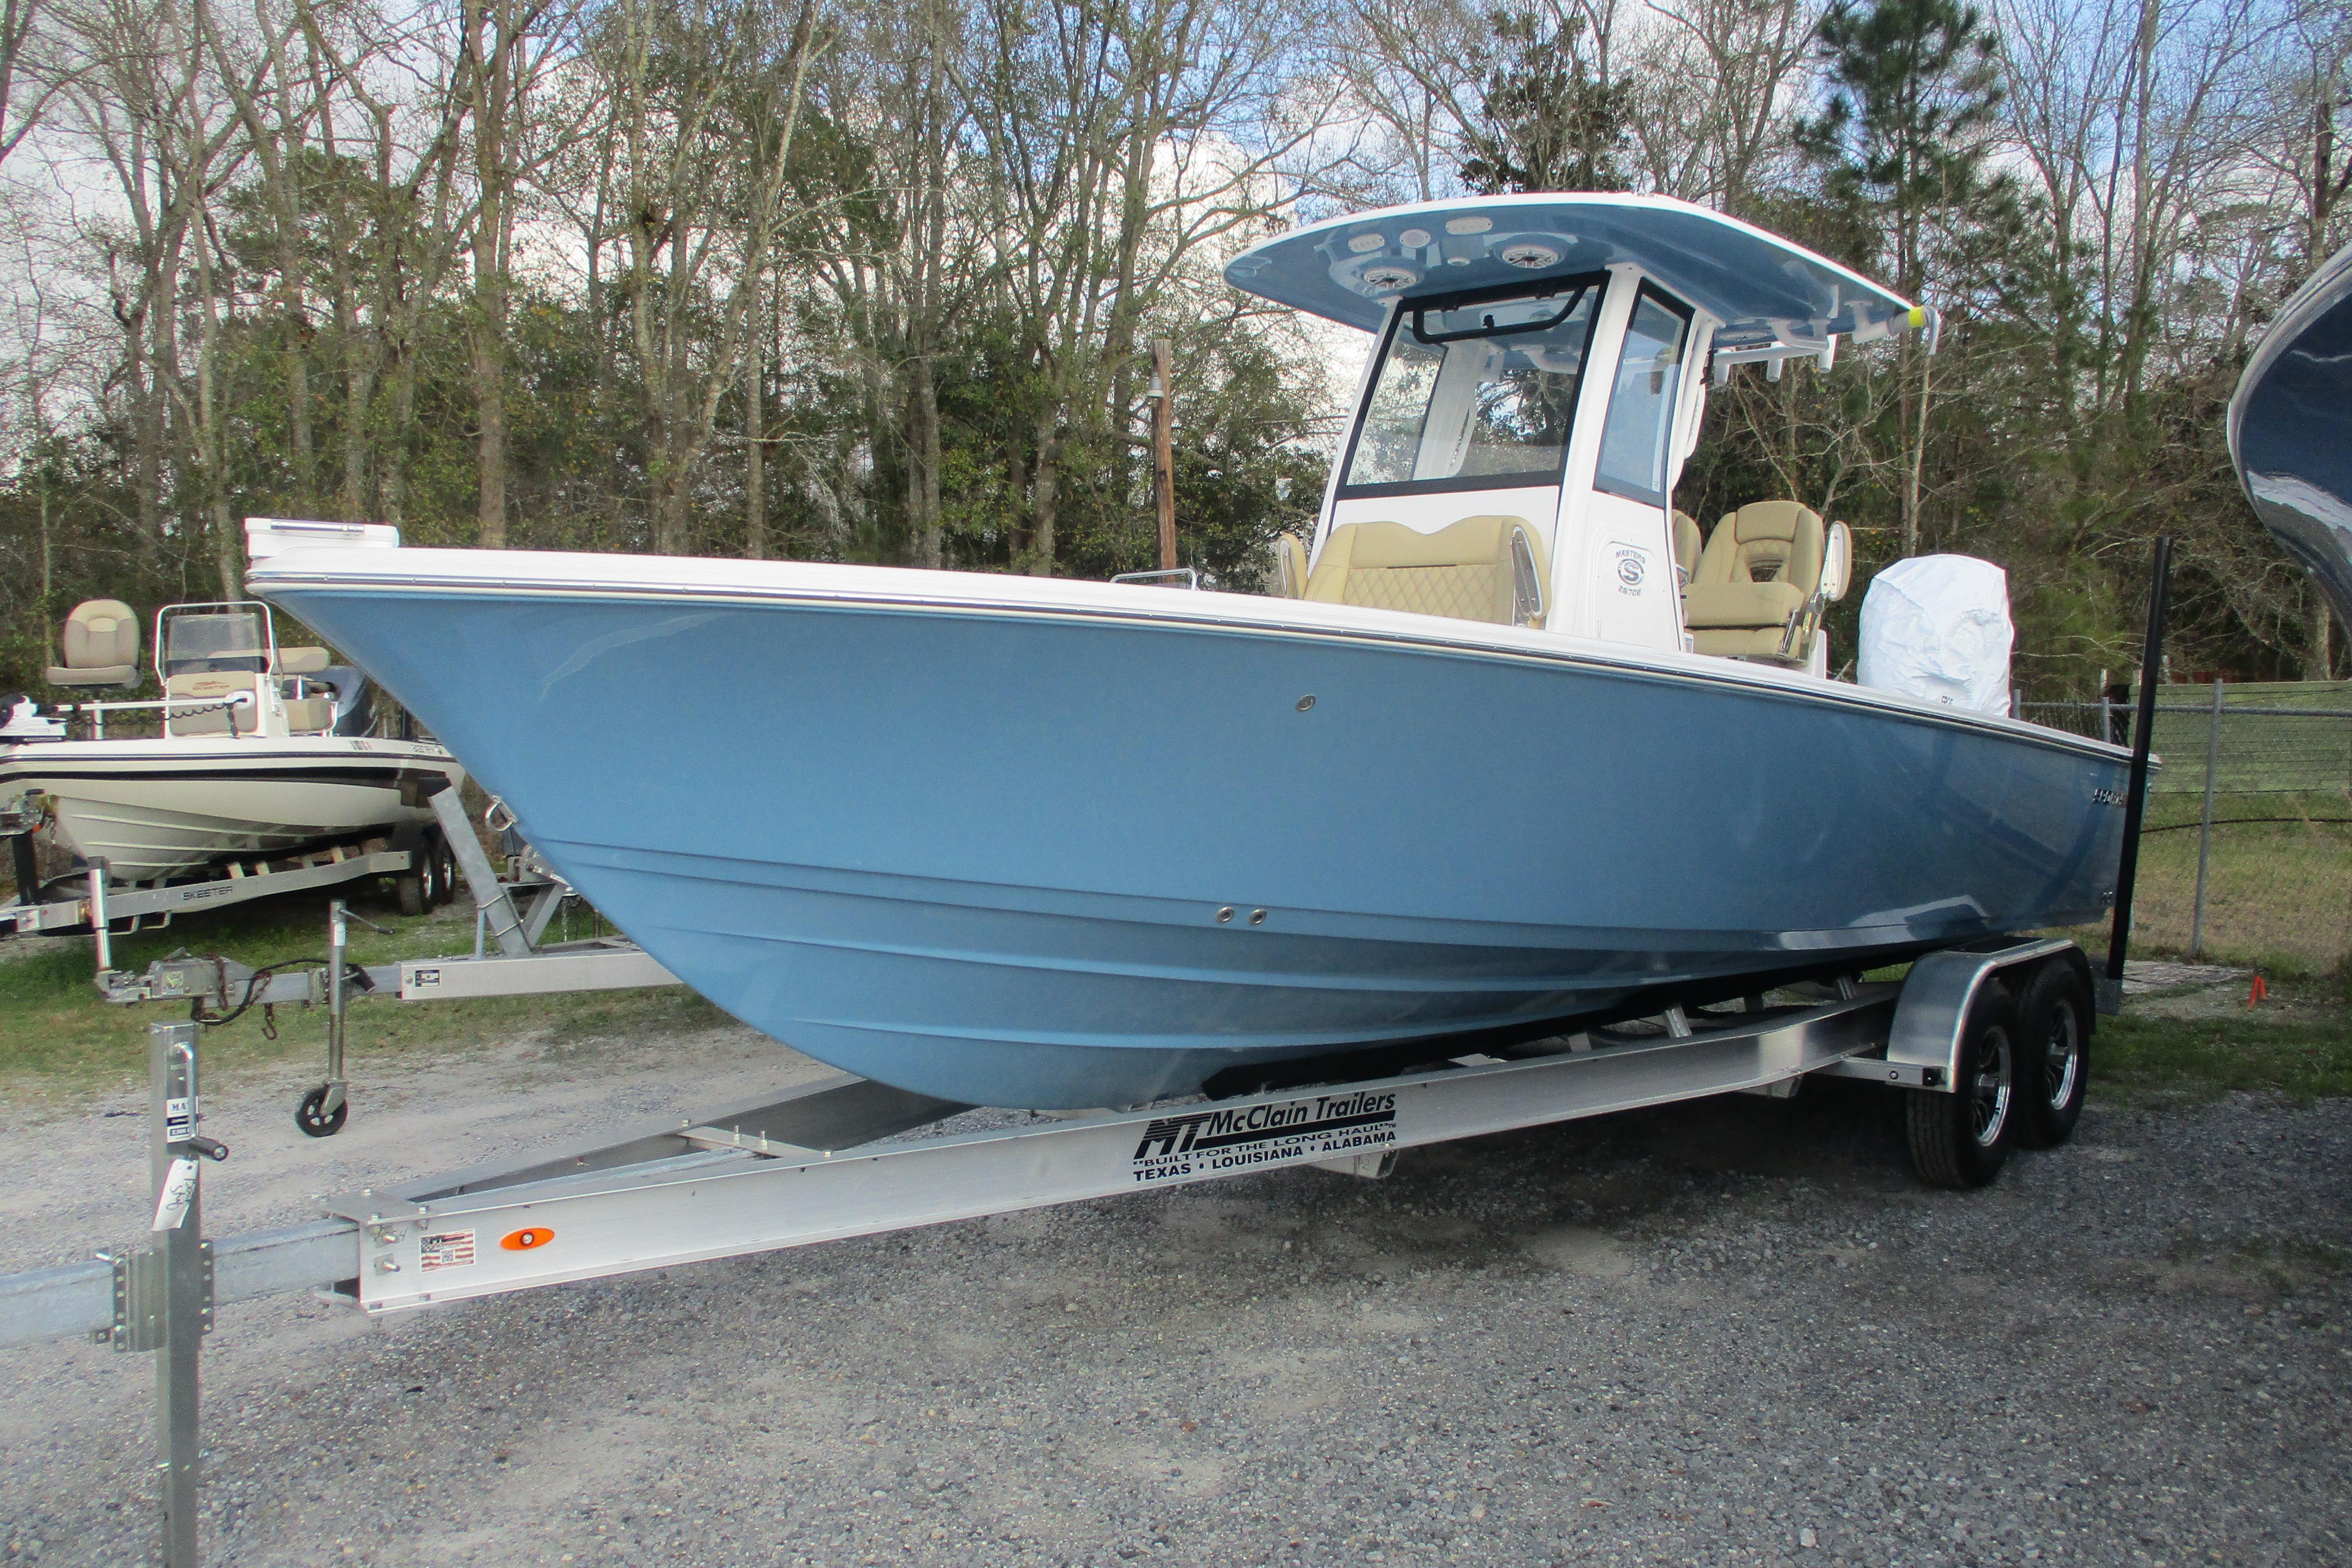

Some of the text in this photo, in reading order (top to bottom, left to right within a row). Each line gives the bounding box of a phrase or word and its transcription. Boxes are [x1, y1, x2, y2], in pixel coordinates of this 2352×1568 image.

[1615, 550, 1646, 564] MASTERS
[184, 886, 233, 901] SKEETER
[1207, 1091, 1396, 1136] McClain Trailers
[1133, 1131, 1396, 1182] TEXAS LOUISIANA ALABAMA
[1197, 1147, 1231, 1159] FOR
[1236, 1141, 1267, 1153] THE
[1274, 1132, 1332, 1147] LONG
